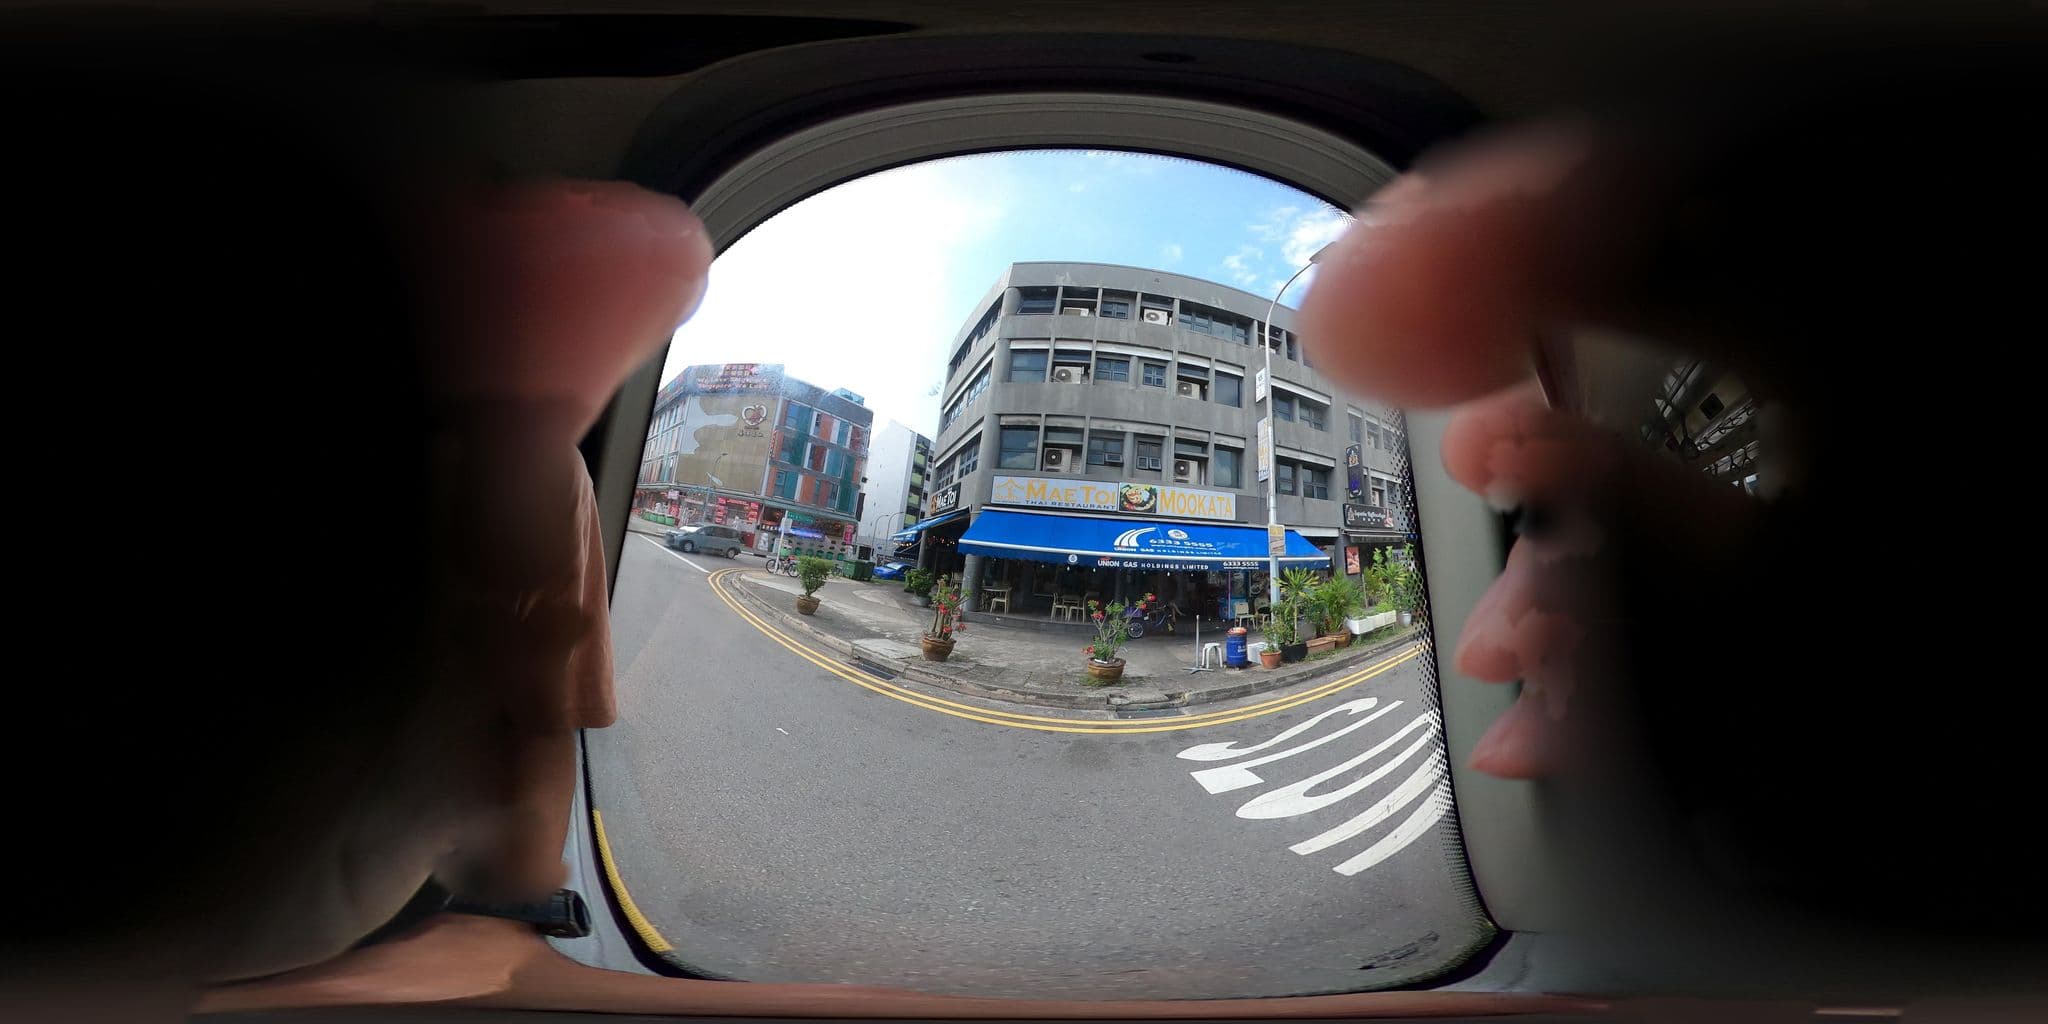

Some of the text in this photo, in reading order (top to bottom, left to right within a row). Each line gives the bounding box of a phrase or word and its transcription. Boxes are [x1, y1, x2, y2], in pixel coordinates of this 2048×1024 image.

[1025, 480, 1117, 505] MAE TOI
[1159, 487, 1233, 517] MOOKATA
[1051, 501, 1116, 510] RESTAURANT
[1097, 560, 1120, 568] UNION
[1176, 697, 1452, 876] SLOW
